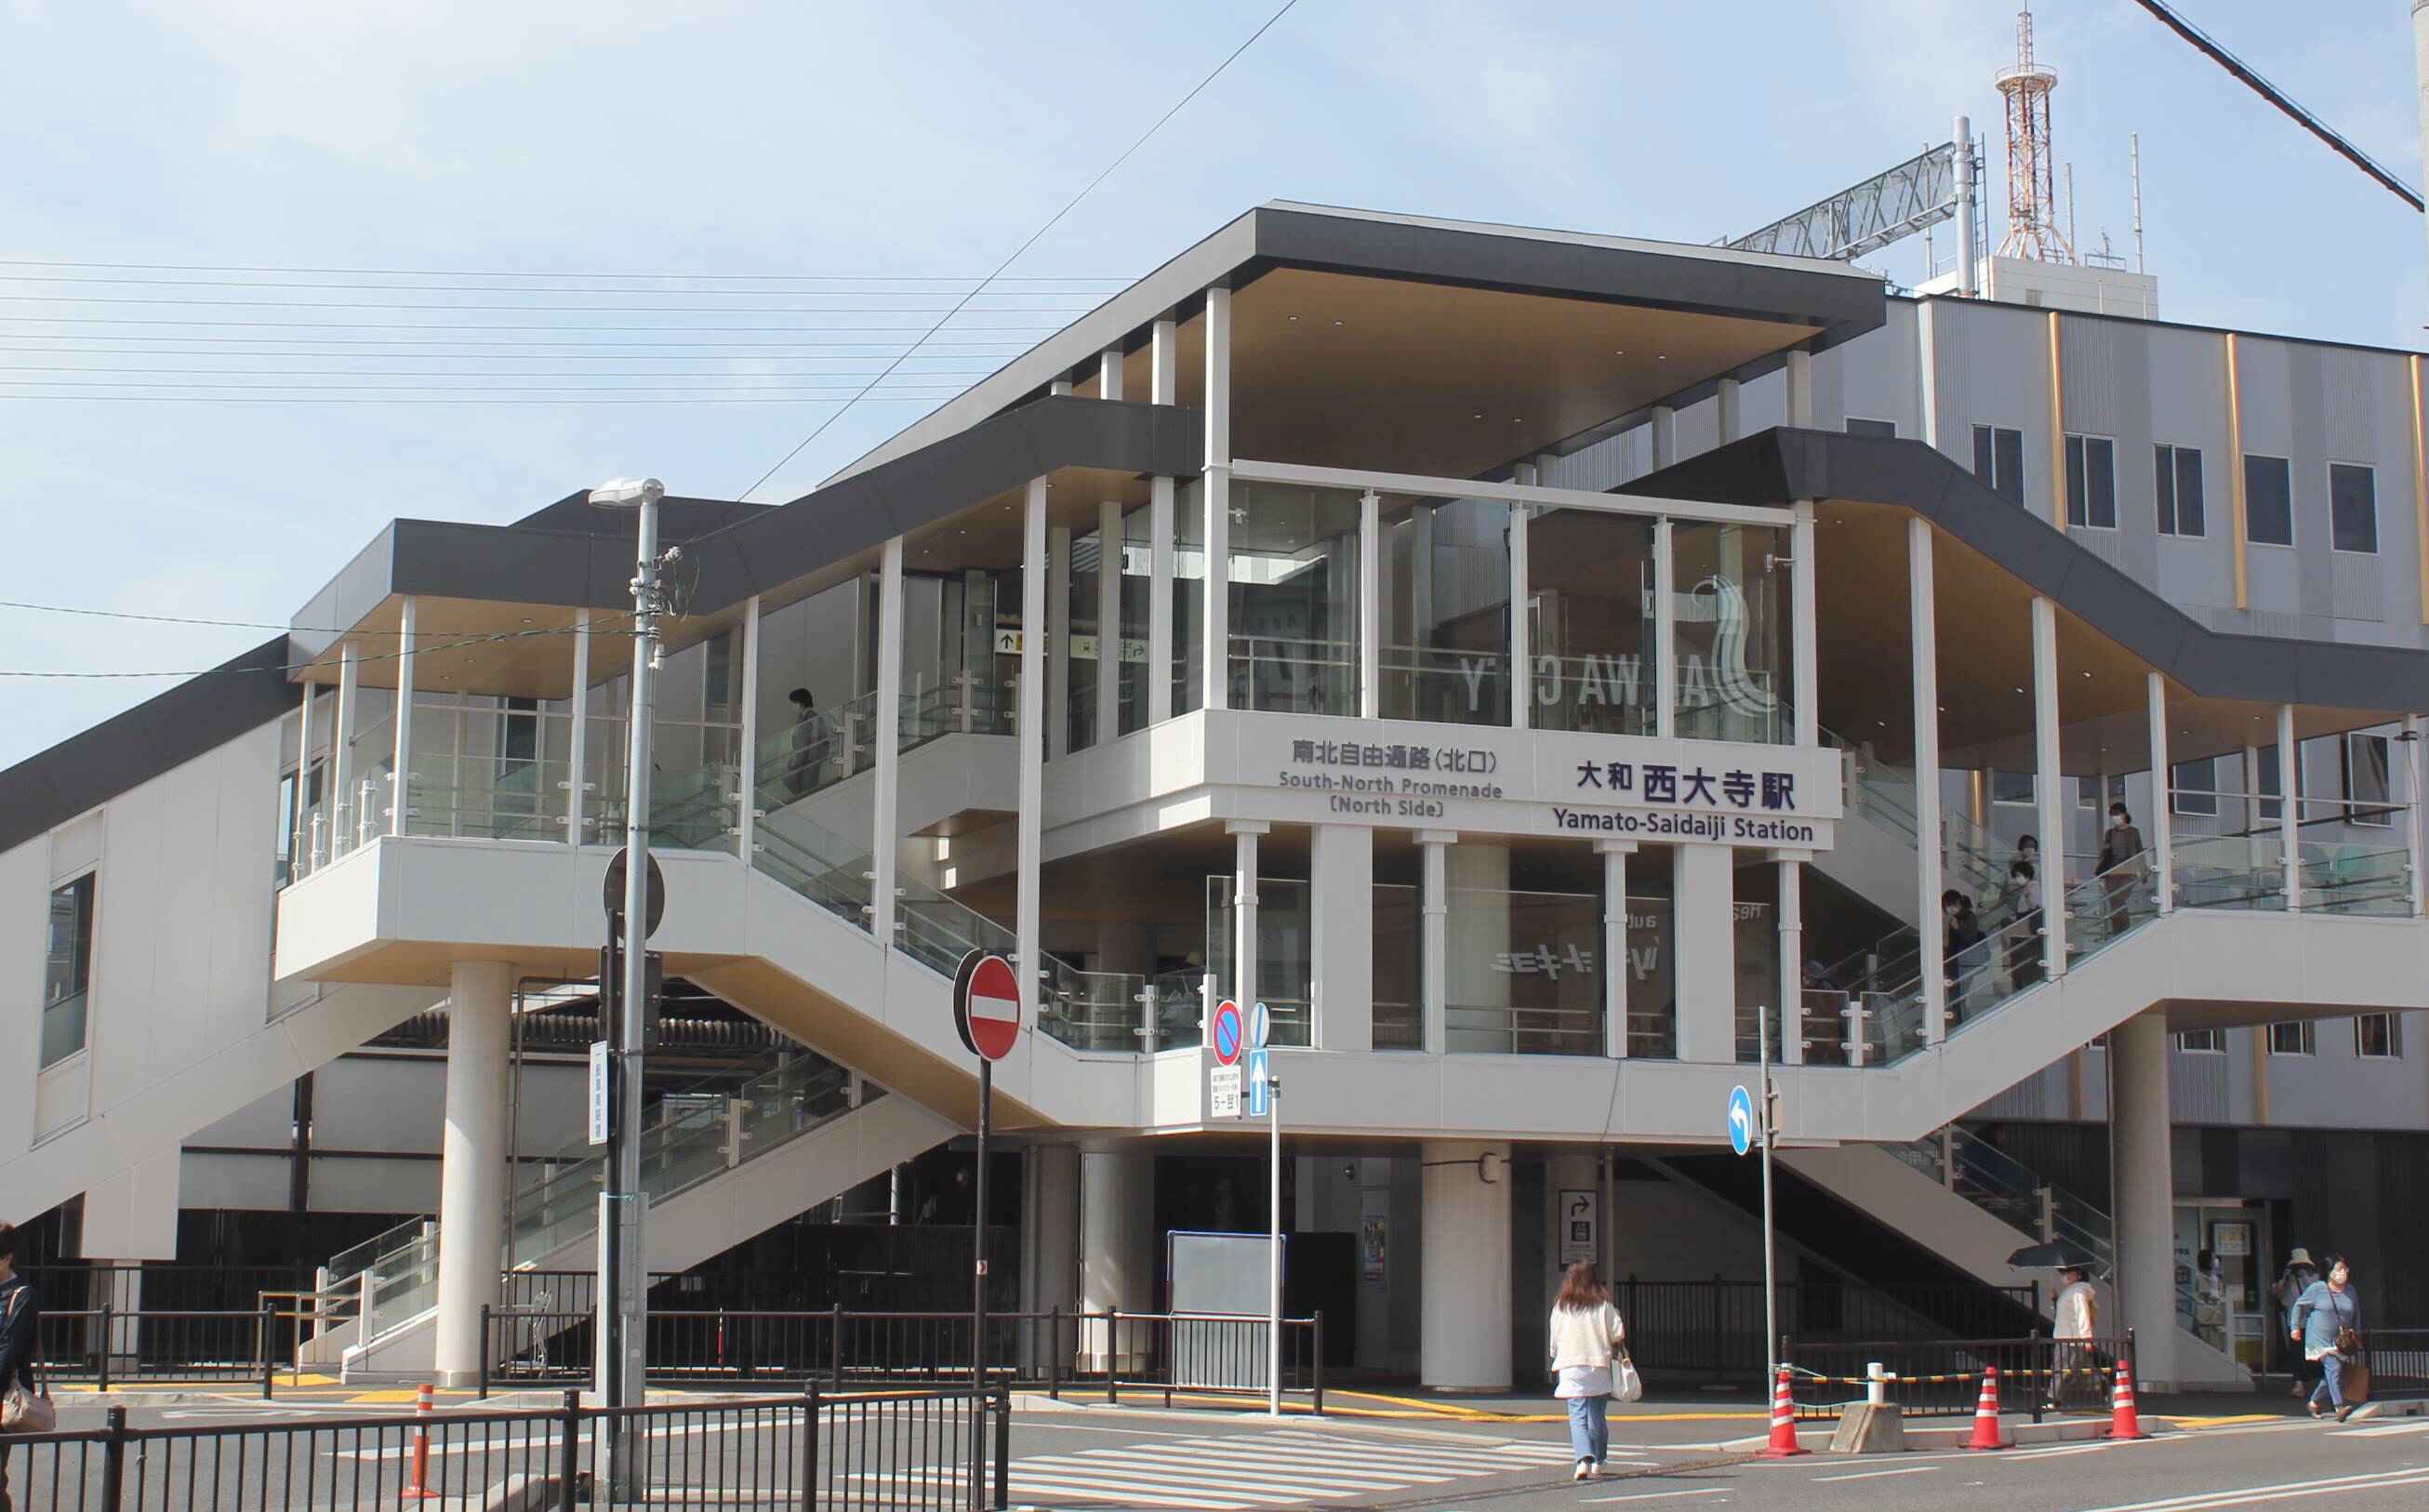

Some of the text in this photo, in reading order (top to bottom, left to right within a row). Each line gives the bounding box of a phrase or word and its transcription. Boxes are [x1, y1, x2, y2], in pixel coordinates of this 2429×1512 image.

[1292, 739, 1497, 775] 南北自由通路（北口）
[1279, 771, 1503, 799] South-North Promenade
[1577, 760, 1796, 811] 大和西大寺駅
[1552, 807, 1814, 842] Yamato-Saidaiji Station
